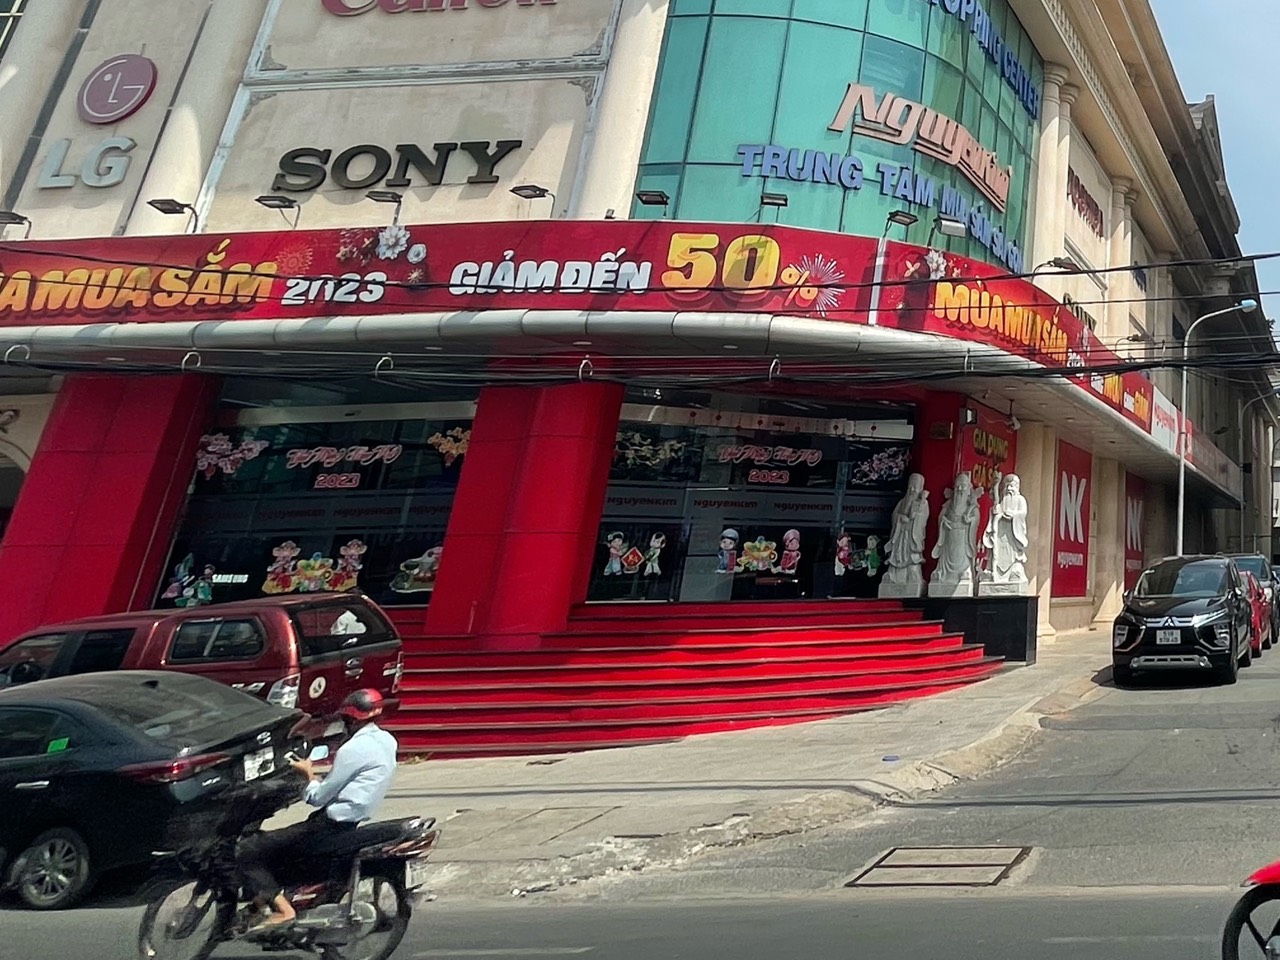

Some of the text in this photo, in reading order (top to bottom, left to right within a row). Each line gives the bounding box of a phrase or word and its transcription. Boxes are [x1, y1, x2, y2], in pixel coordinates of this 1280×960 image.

[1001, 50, 1039, 119] CENTER
[38, 135, 137, 189] LG
[272, 140, 522, 193] SONY
[737, 144, 863, 191] TRUNG
[877, 162, 934, 208] TÂM
[940, 184, 970, 227] MUA
[314, 473, 361, 489] 2023
[747, 469, 790, 484] 2023
[1059, 470, 1087, 543] NK
[1127, 495, 1143, 552] NK
